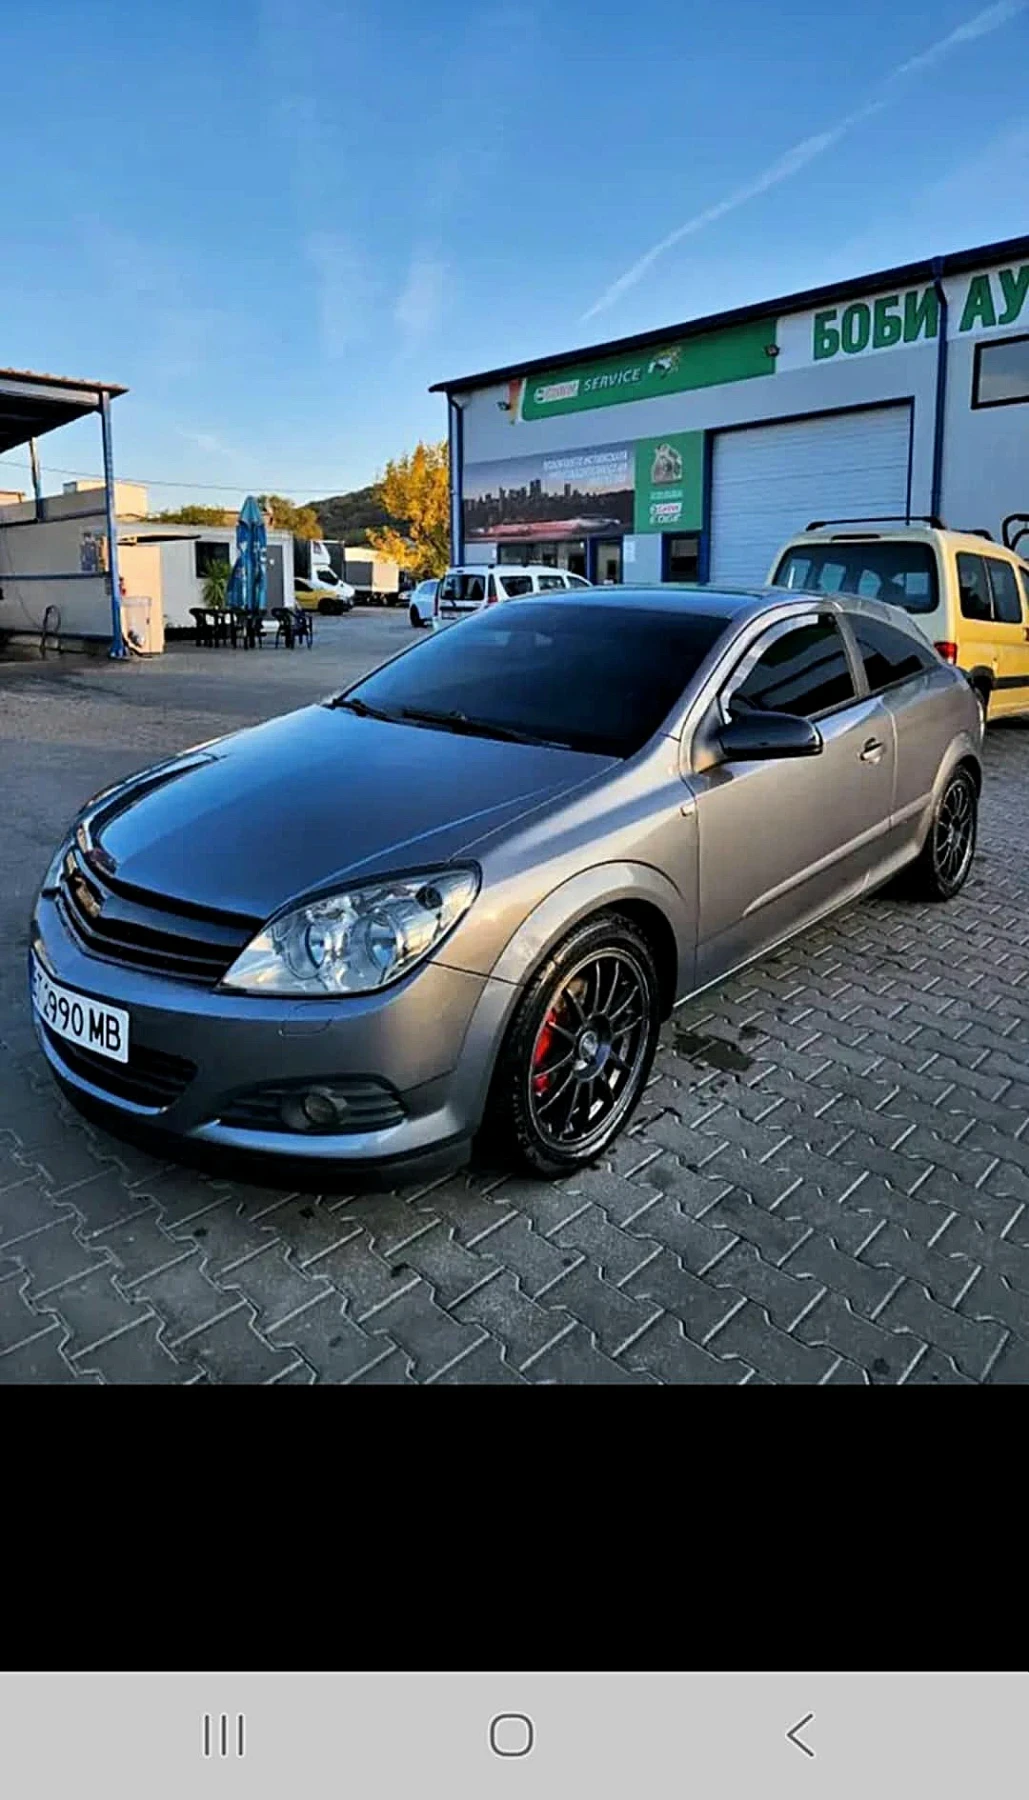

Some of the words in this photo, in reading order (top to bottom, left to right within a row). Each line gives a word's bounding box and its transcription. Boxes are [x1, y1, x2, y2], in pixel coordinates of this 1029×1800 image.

[813, 286, 939, 361] БОБИ
[583, 367, 641, 392] SERVICE
[89, 1008, 121, 1052] MB
